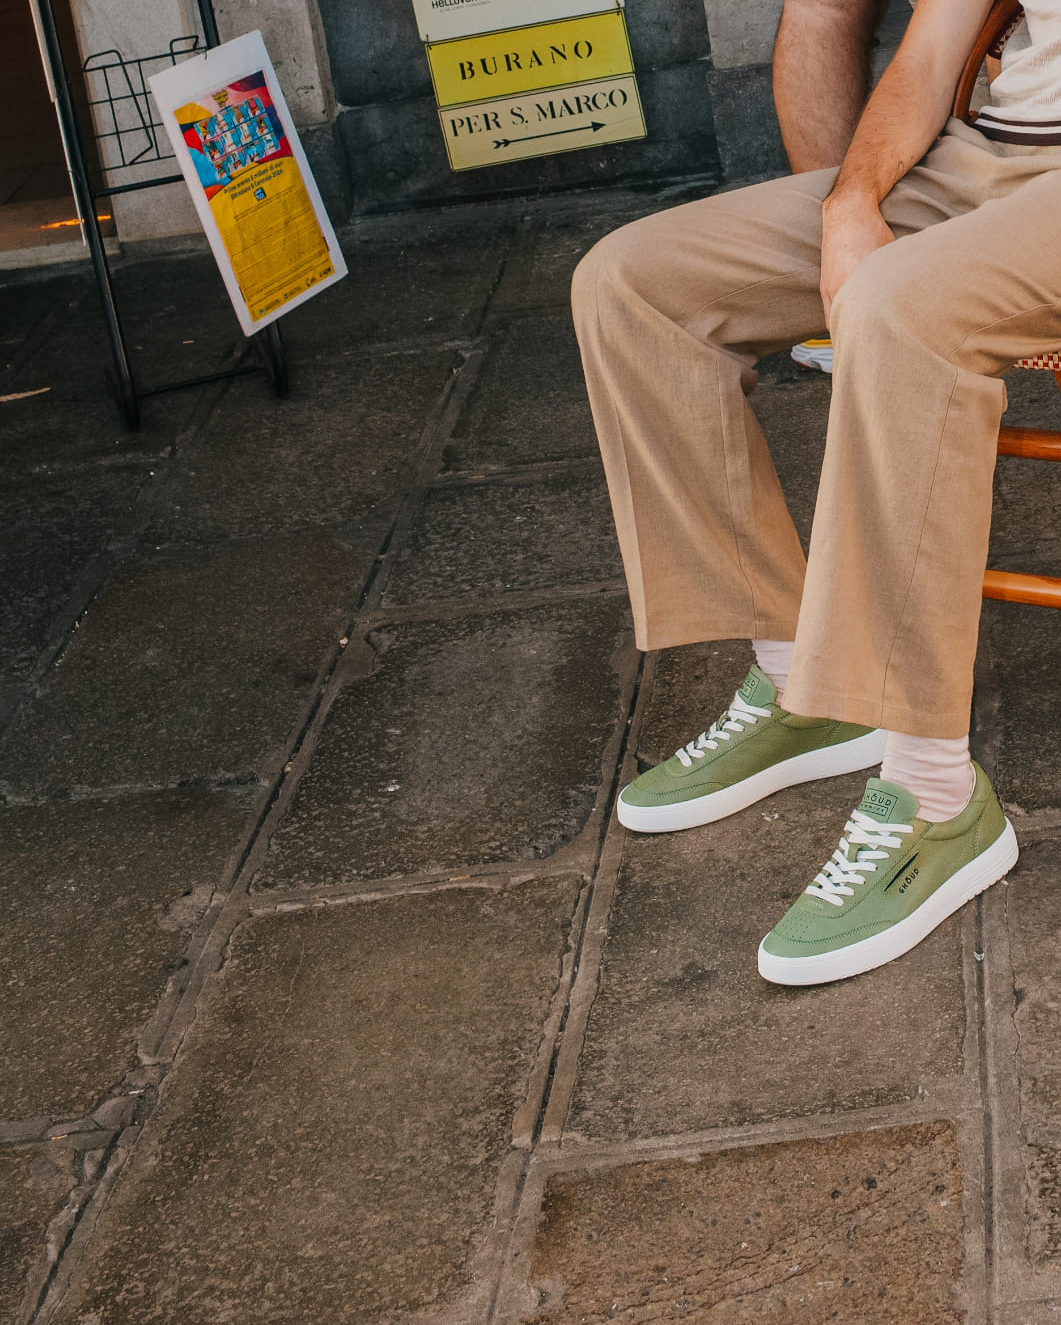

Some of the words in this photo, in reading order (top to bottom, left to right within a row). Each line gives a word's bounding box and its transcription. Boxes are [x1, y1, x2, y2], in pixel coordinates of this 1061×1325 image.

[458, 40, 594, 81] BURANO
[450, 111, 502, 137] PER
[510, 106, 529, 126] S.
[535, 88, 628, 122] MARCO
